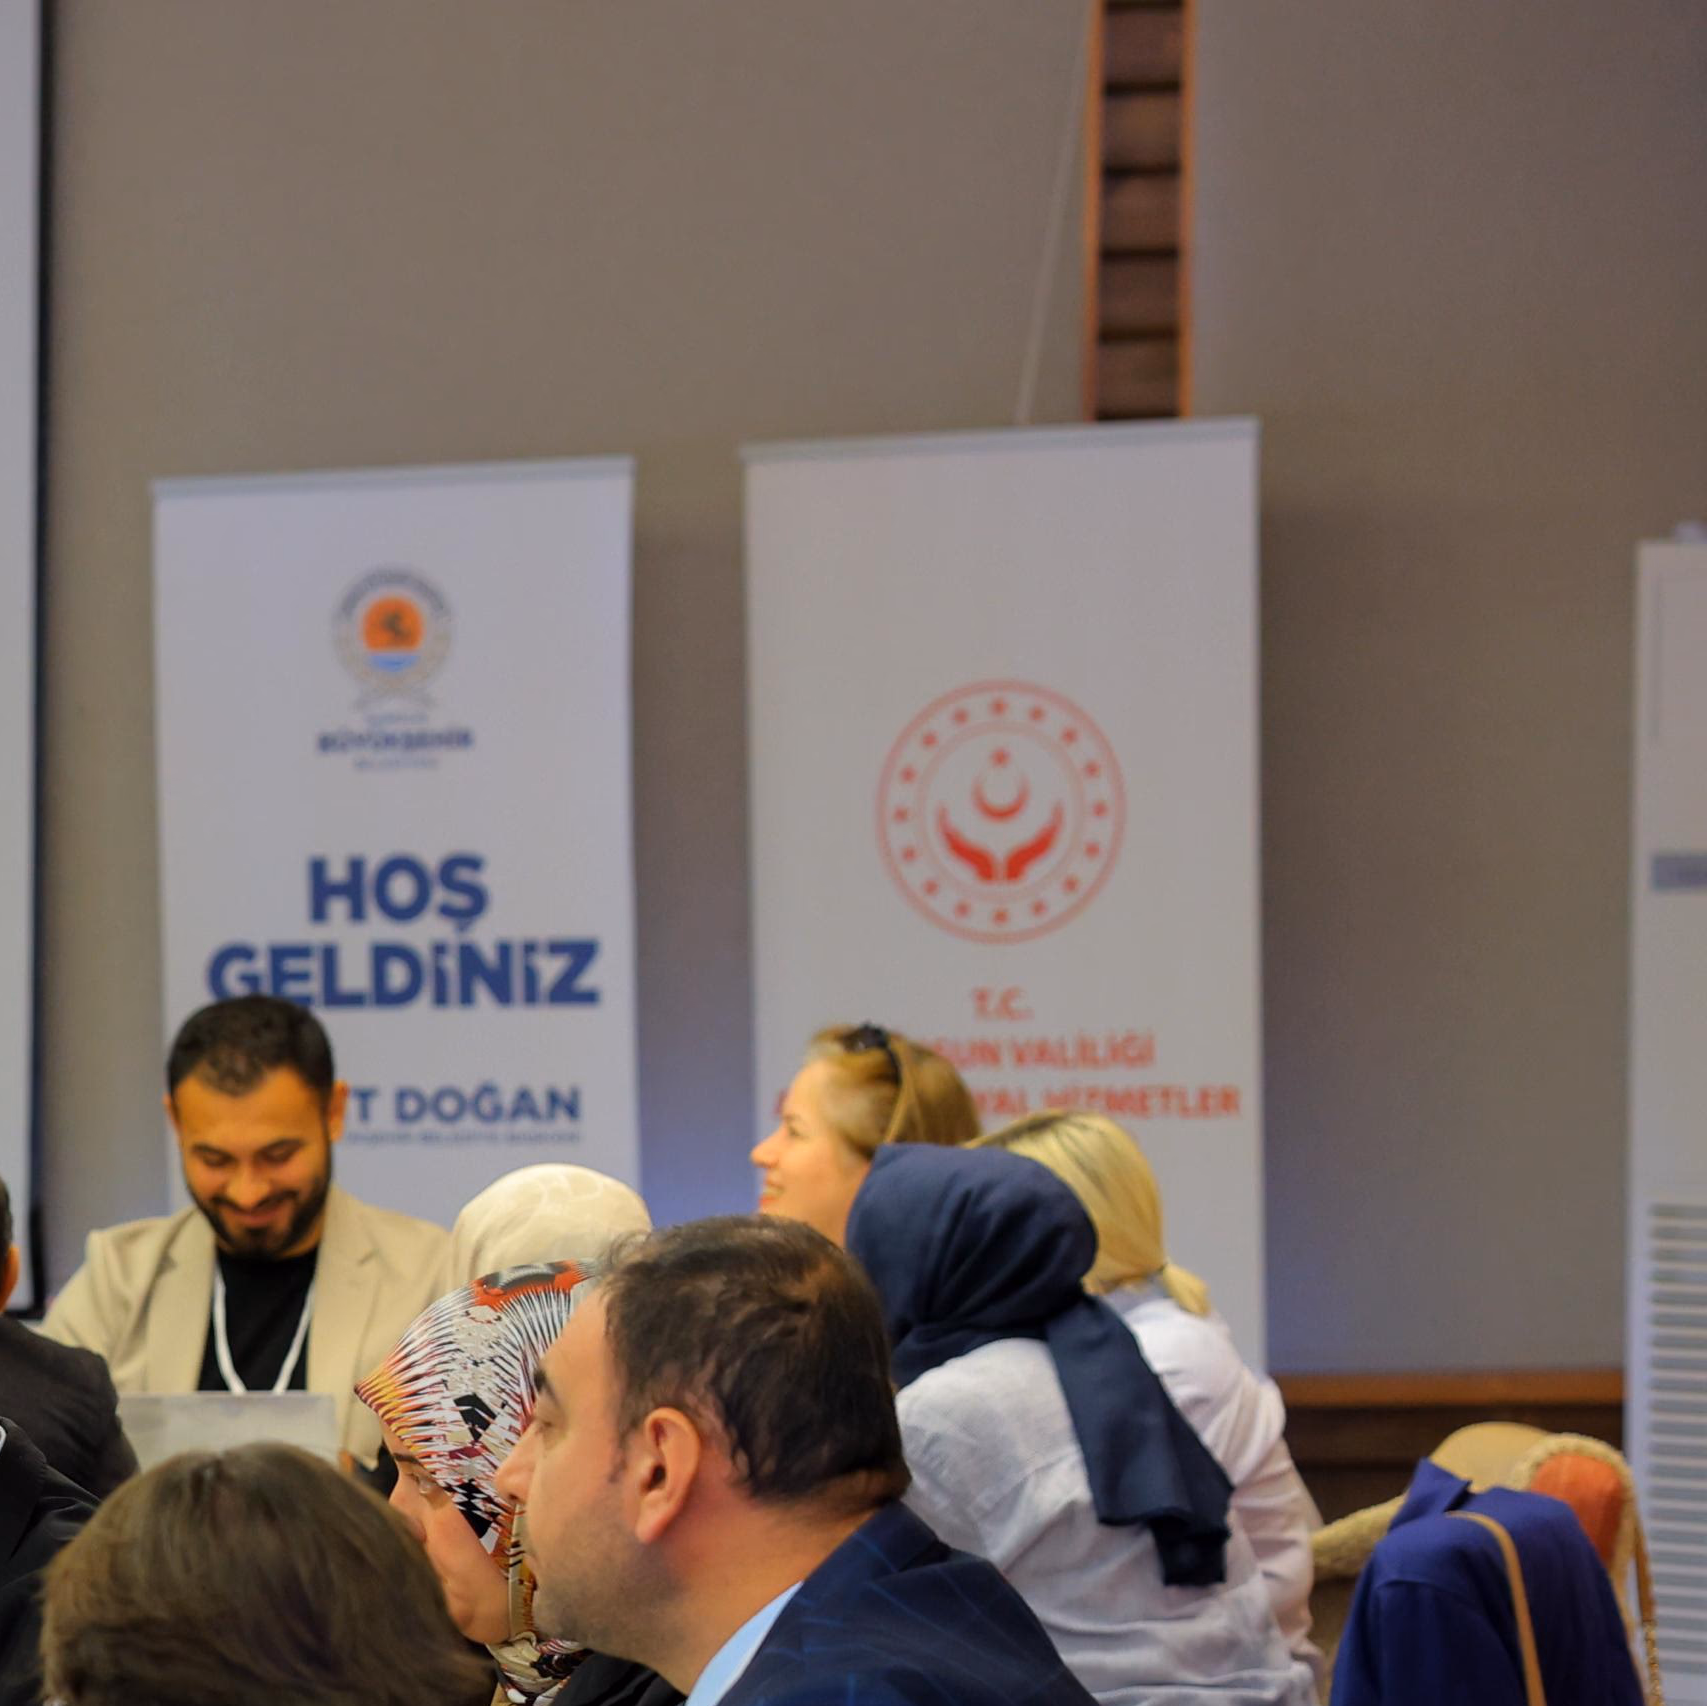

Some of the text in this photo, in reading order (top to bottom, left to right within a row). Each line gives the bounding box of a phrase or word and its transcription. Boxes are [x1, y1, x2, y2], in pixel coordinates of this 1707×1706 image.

[307, 853, 490, 933] HOŞ
[972, 986, 1034, 1020] T.C.
[1012, 1028, 1156, 1069] VALİLİĞİ
[395, 1080, 581, 1124] DOĞAN
